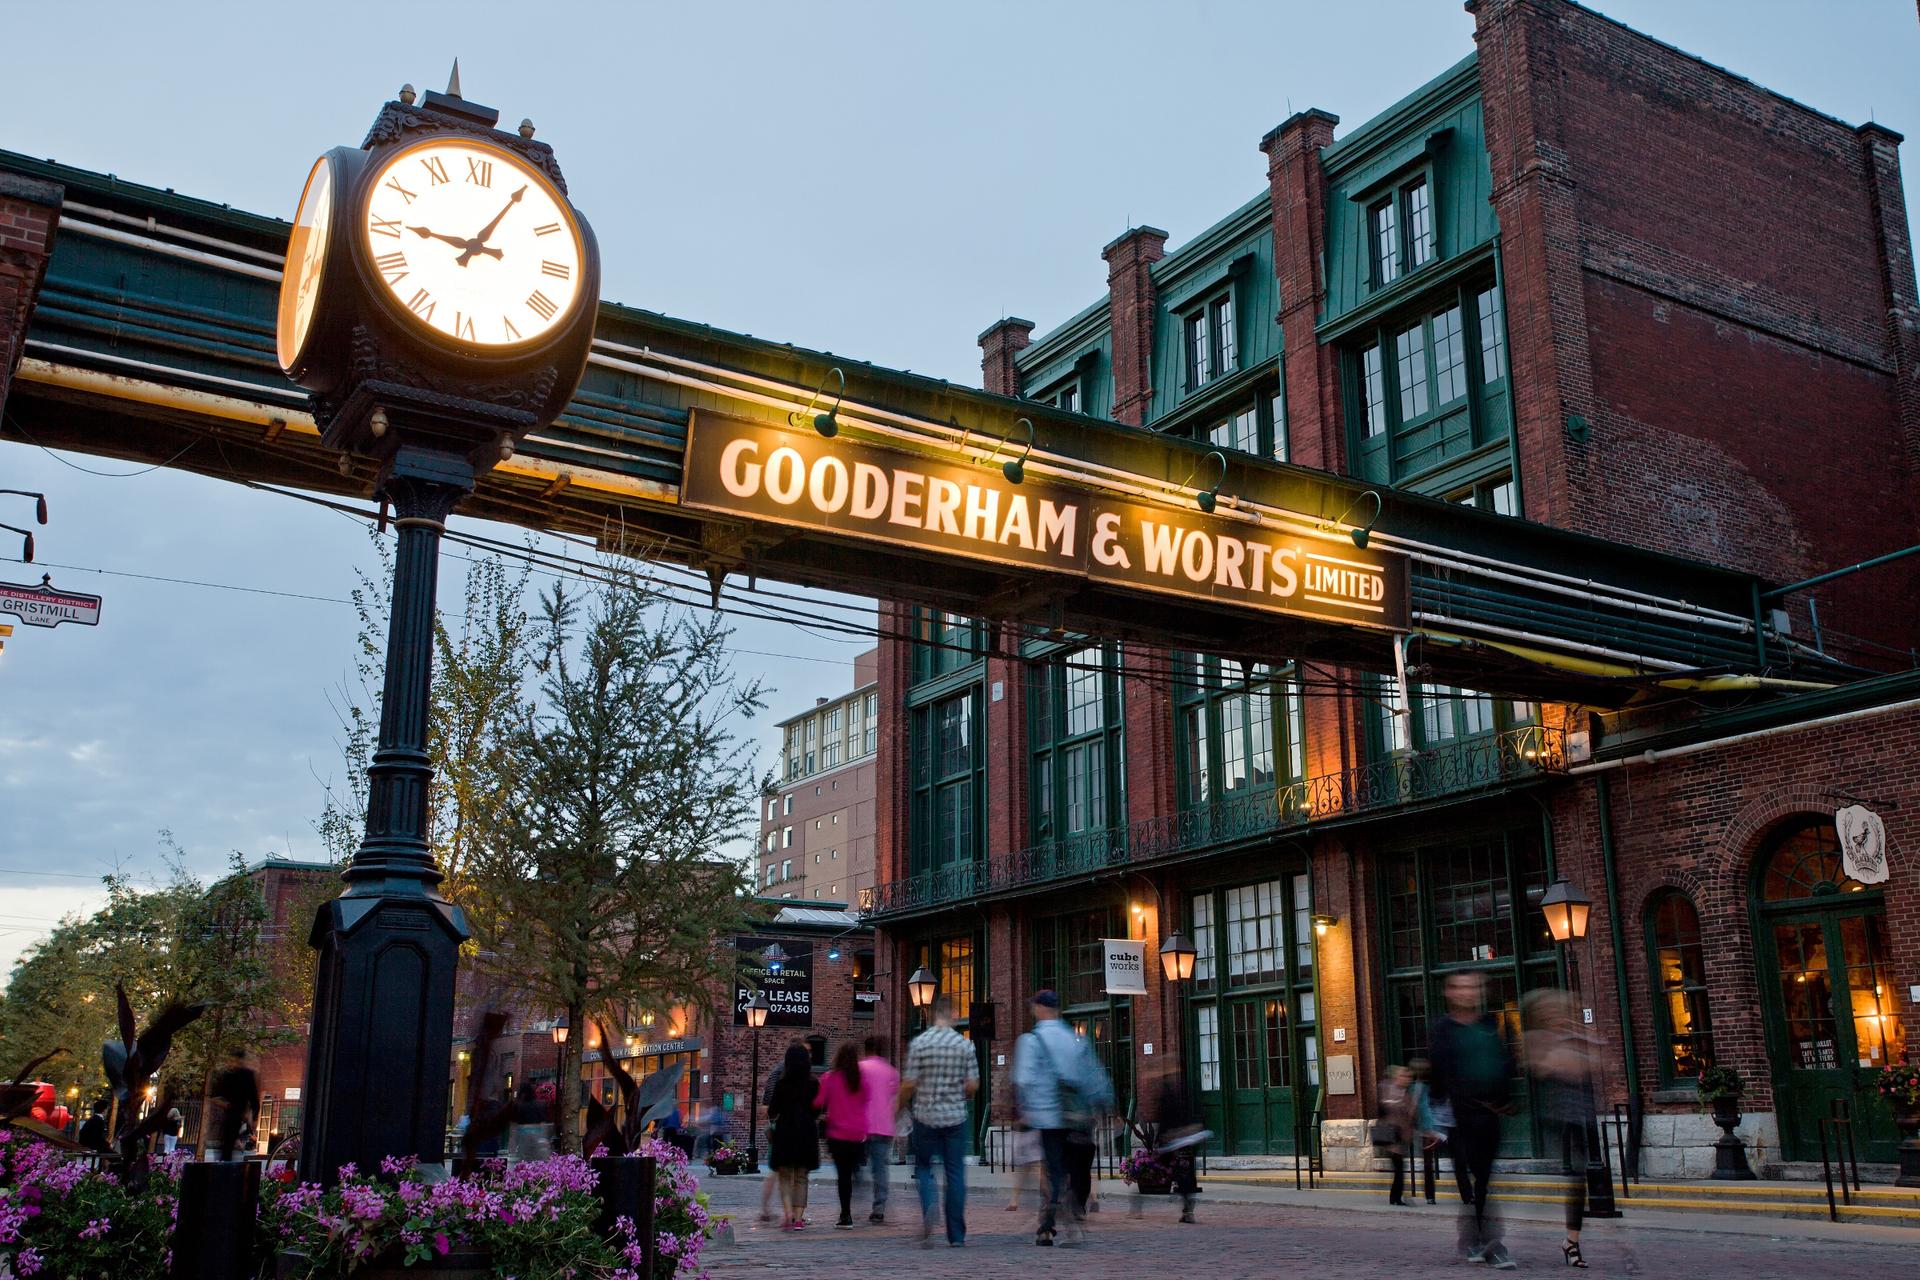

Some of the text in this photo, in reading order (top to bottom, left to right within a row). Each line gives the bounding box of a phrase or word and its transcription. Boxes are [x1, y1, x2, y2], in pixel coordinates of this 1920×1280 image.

[719, 438, 1298, 599] GOODERHAM & WORTS
[1304, 561, 1386, 604] LIMITED
[10, 591, 56, 603] DISTILLERY
[57, 597, 94, 608] DISTRICT
[3, 599, 79, 619] GRISTMILL
[30, 616, 50, 624] LANE
[1110, 952, 1139, 962] cube
[1110, 962, 1140, 971] works
[780, 969, 806, 978] RETAIL
[764, 977, 785, 985] SPACE
[769, 990, 810, 1002] LEASE
[770, 1004, 810, 1014] 07-3450
[663, 1041, 685, 1051] CENTRE
